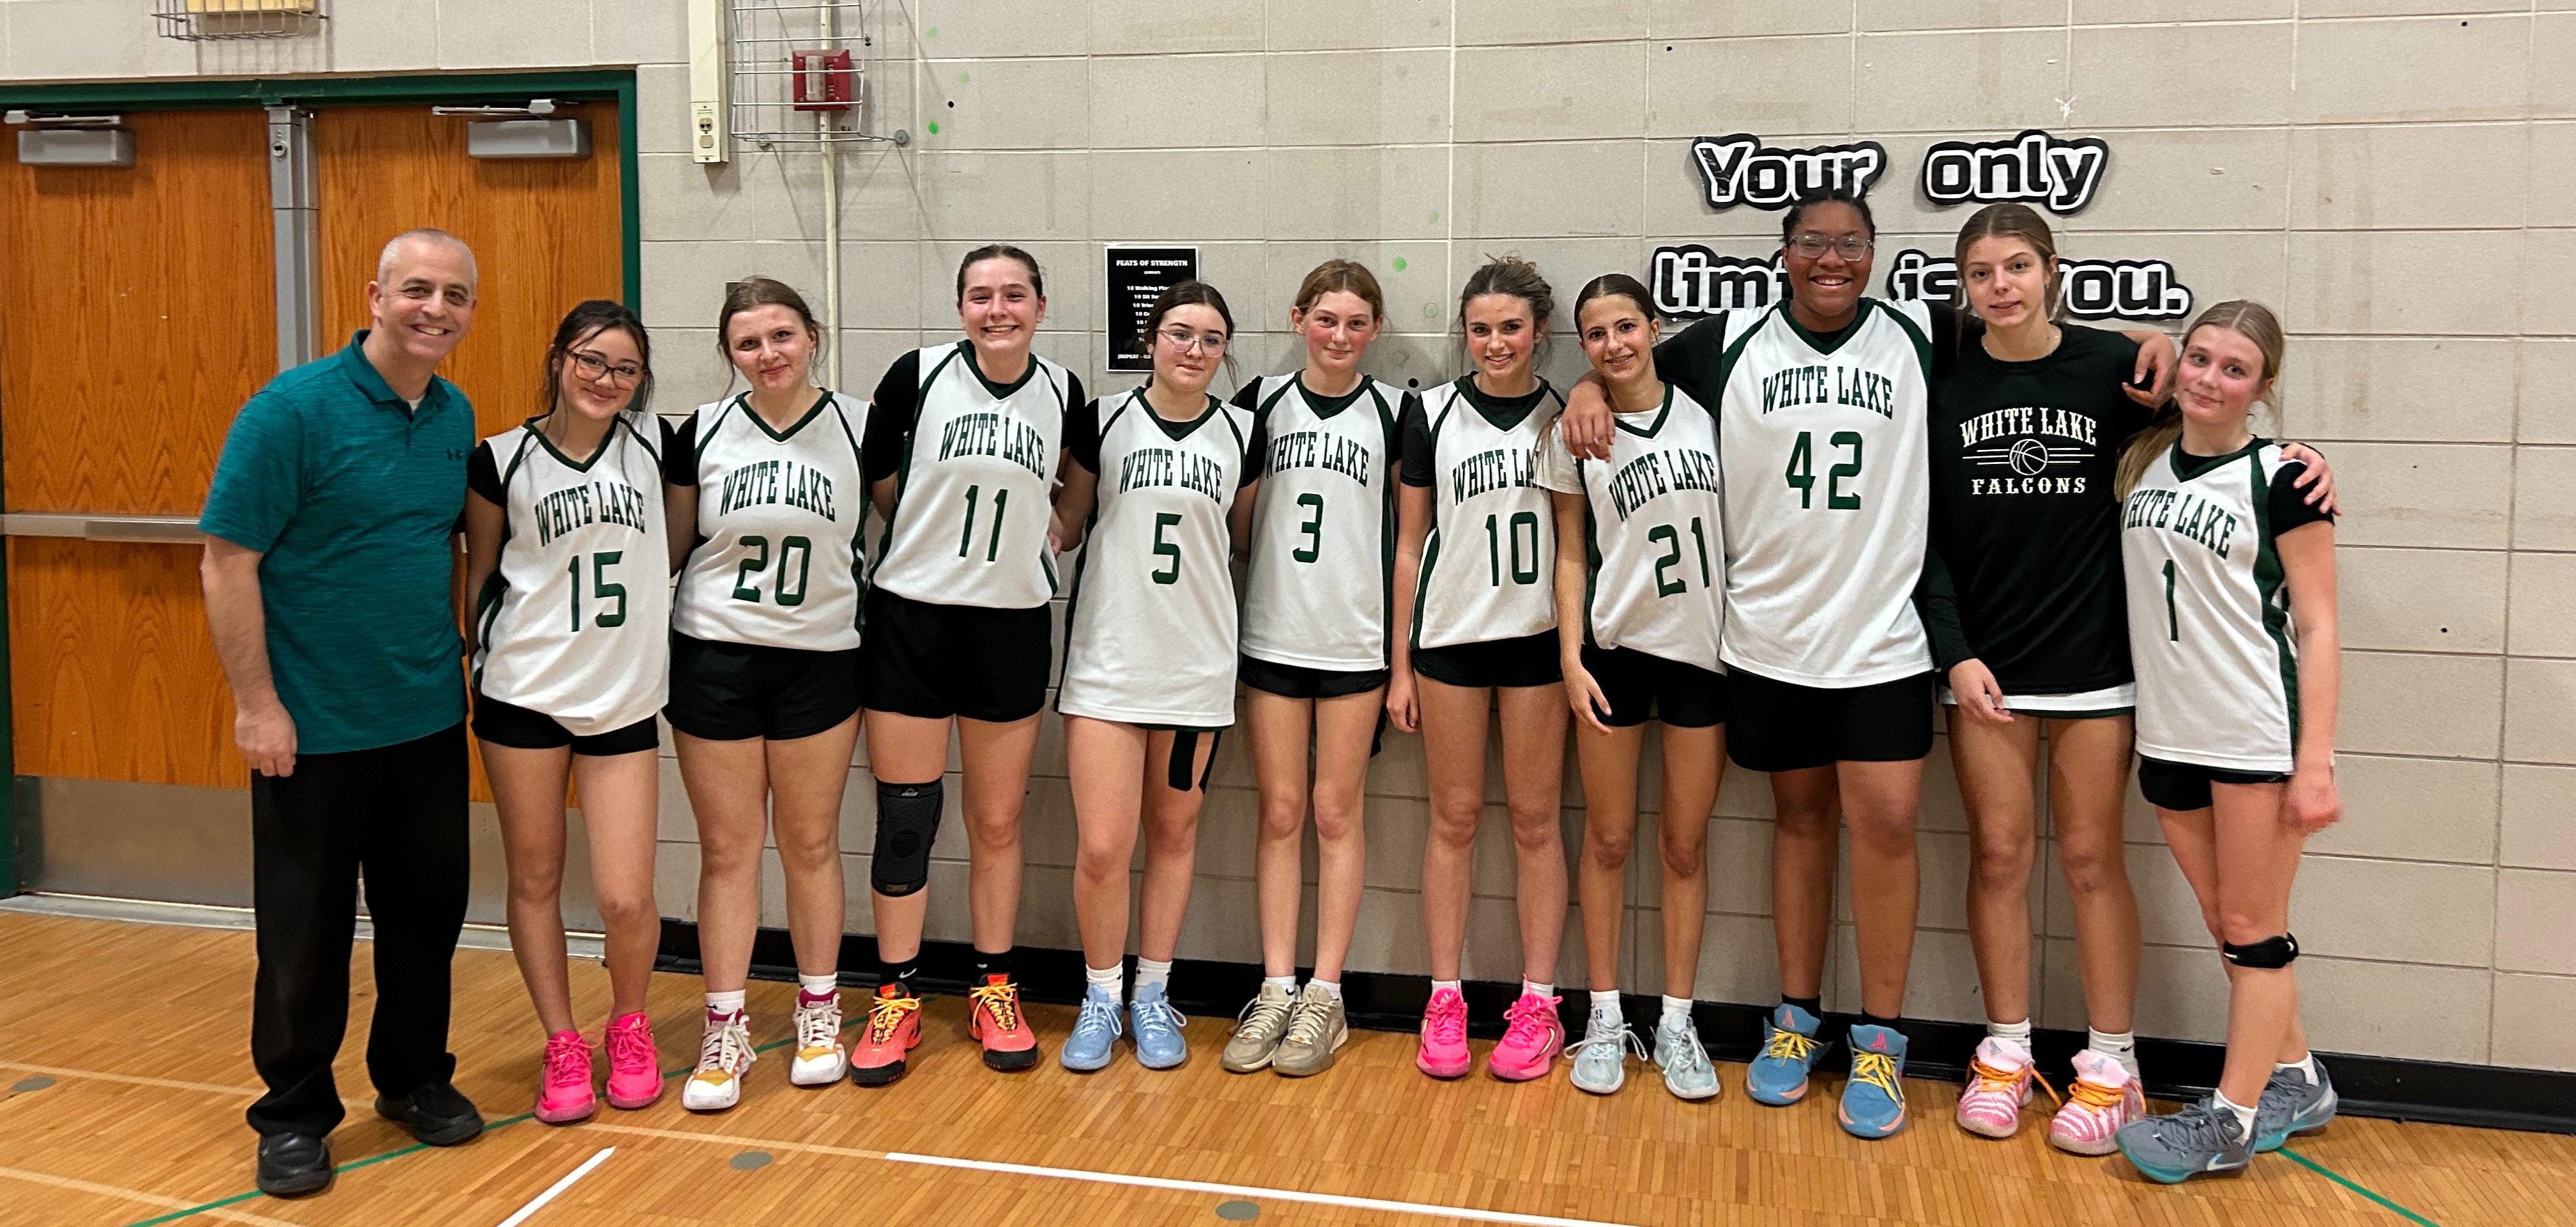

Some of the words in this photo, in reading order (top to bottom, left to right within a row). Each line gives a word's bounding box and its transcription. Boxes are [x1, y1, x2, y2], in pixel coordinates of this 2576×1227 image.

[1697, 144, 1873, 200] Your
[1929, 139, 2099, 207] only
[1660, 256, 1794, 310] limi
[1897, 258, 1958, 302] is
[2055, 268, 2182, 312] ou.
[1763, 365, 1828, 414] WHITE
[1837, 366, 1892, 419] LAKE
[938, 413, 999, 461] WHITE
[1003, 417, 1045, 481] LAKE
[1266, 431, 1317, 479] WHITE
[1322, 432, 1369, 487] LAKE
[1959, 407, 2033, 447] WHITE
[2039, 407, 2096, 447] LAKE
[719, 460, 779, 516] WHITE
[785, 461, 835, 522] LAKE
[1119, 448, 1173, 495] WHITE
[1181, 451, 1222, 504] LAKE
[1452, 449, 1507, 505] WHITE
[1512, 449, 1544, 490] LA
[1608, 452, 1667, 521] WHITE
[1664, 448, 1717, 493] LAKE
[1785, 431, 1862, 510] 42
[1971, 477, 2086, 495] FALCONS
[534, 484, 593, 546] WHITE
[595, 481, 645, 534] LAKE
[958, 484, 1008, 561] 11
[1292, 493, 1323, 563] 3
[2174, 494, 2236, 560] LAKE
[732, 536, 811, 606] 20
[1152, 512, 1182, 584] 5
[1485, 511, 1538, 587] 10
[1648, 516, 1710, 598] 21
[568, 550, 626, 632] 15
[2162, 559, 2179, 642] 1
